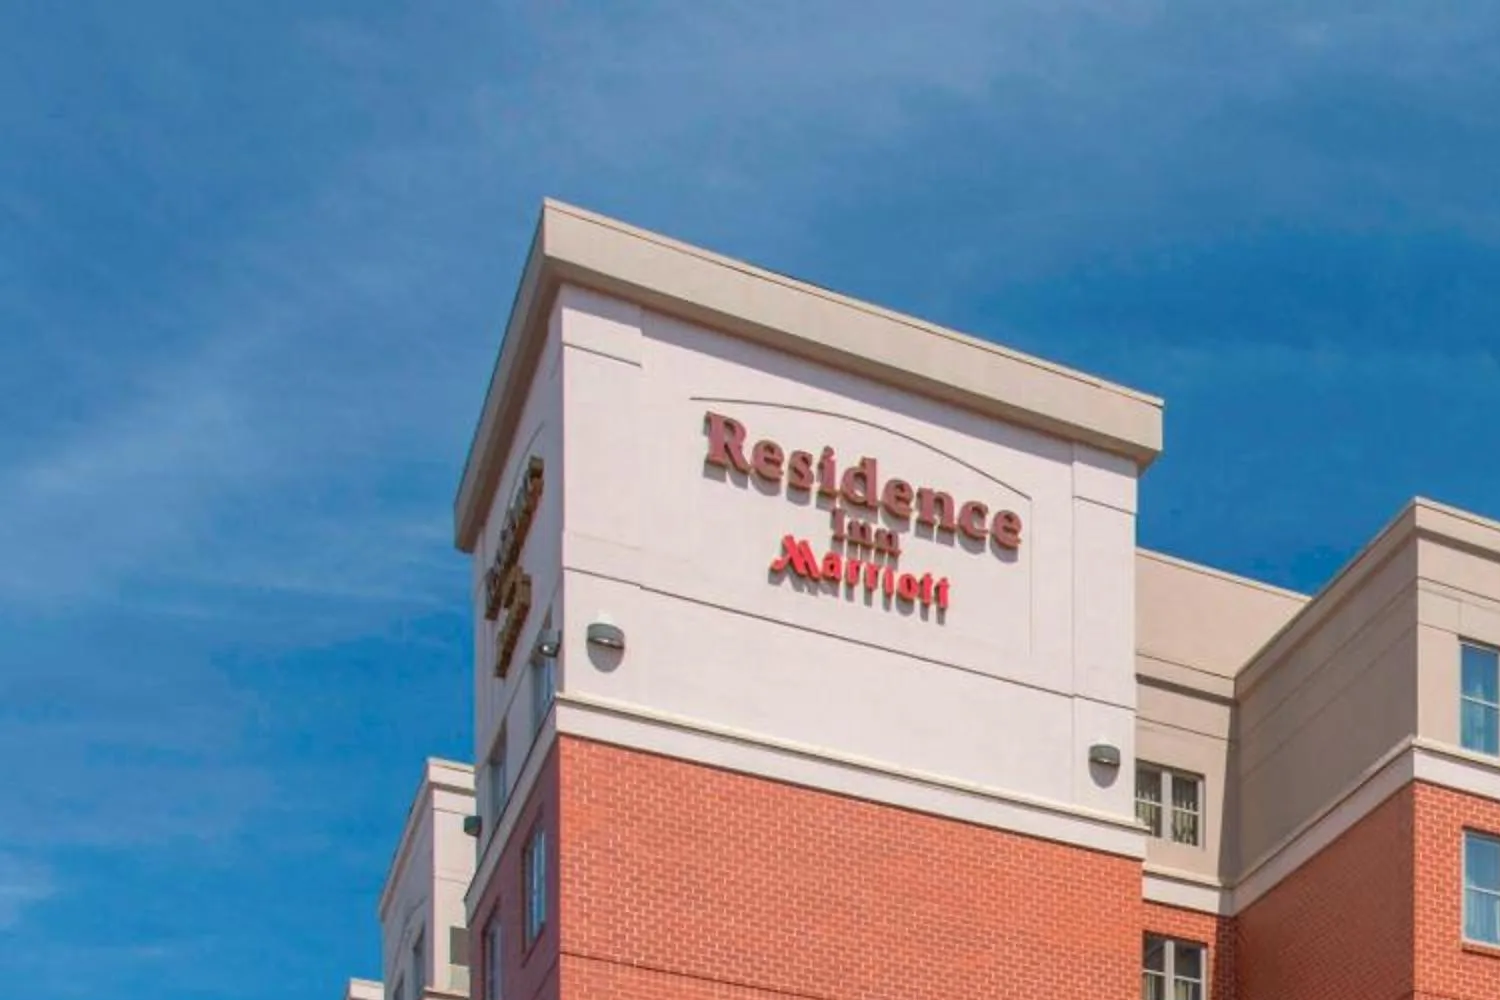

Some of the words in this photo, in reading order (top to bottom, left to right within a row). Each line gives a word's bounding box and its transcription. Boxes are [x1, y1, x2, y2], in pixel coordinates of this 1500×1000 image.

[704, 411, 1022, 550] Residence
[831, 508, 902, 557] Inn
[770, 535, 950, 610] Marriott
